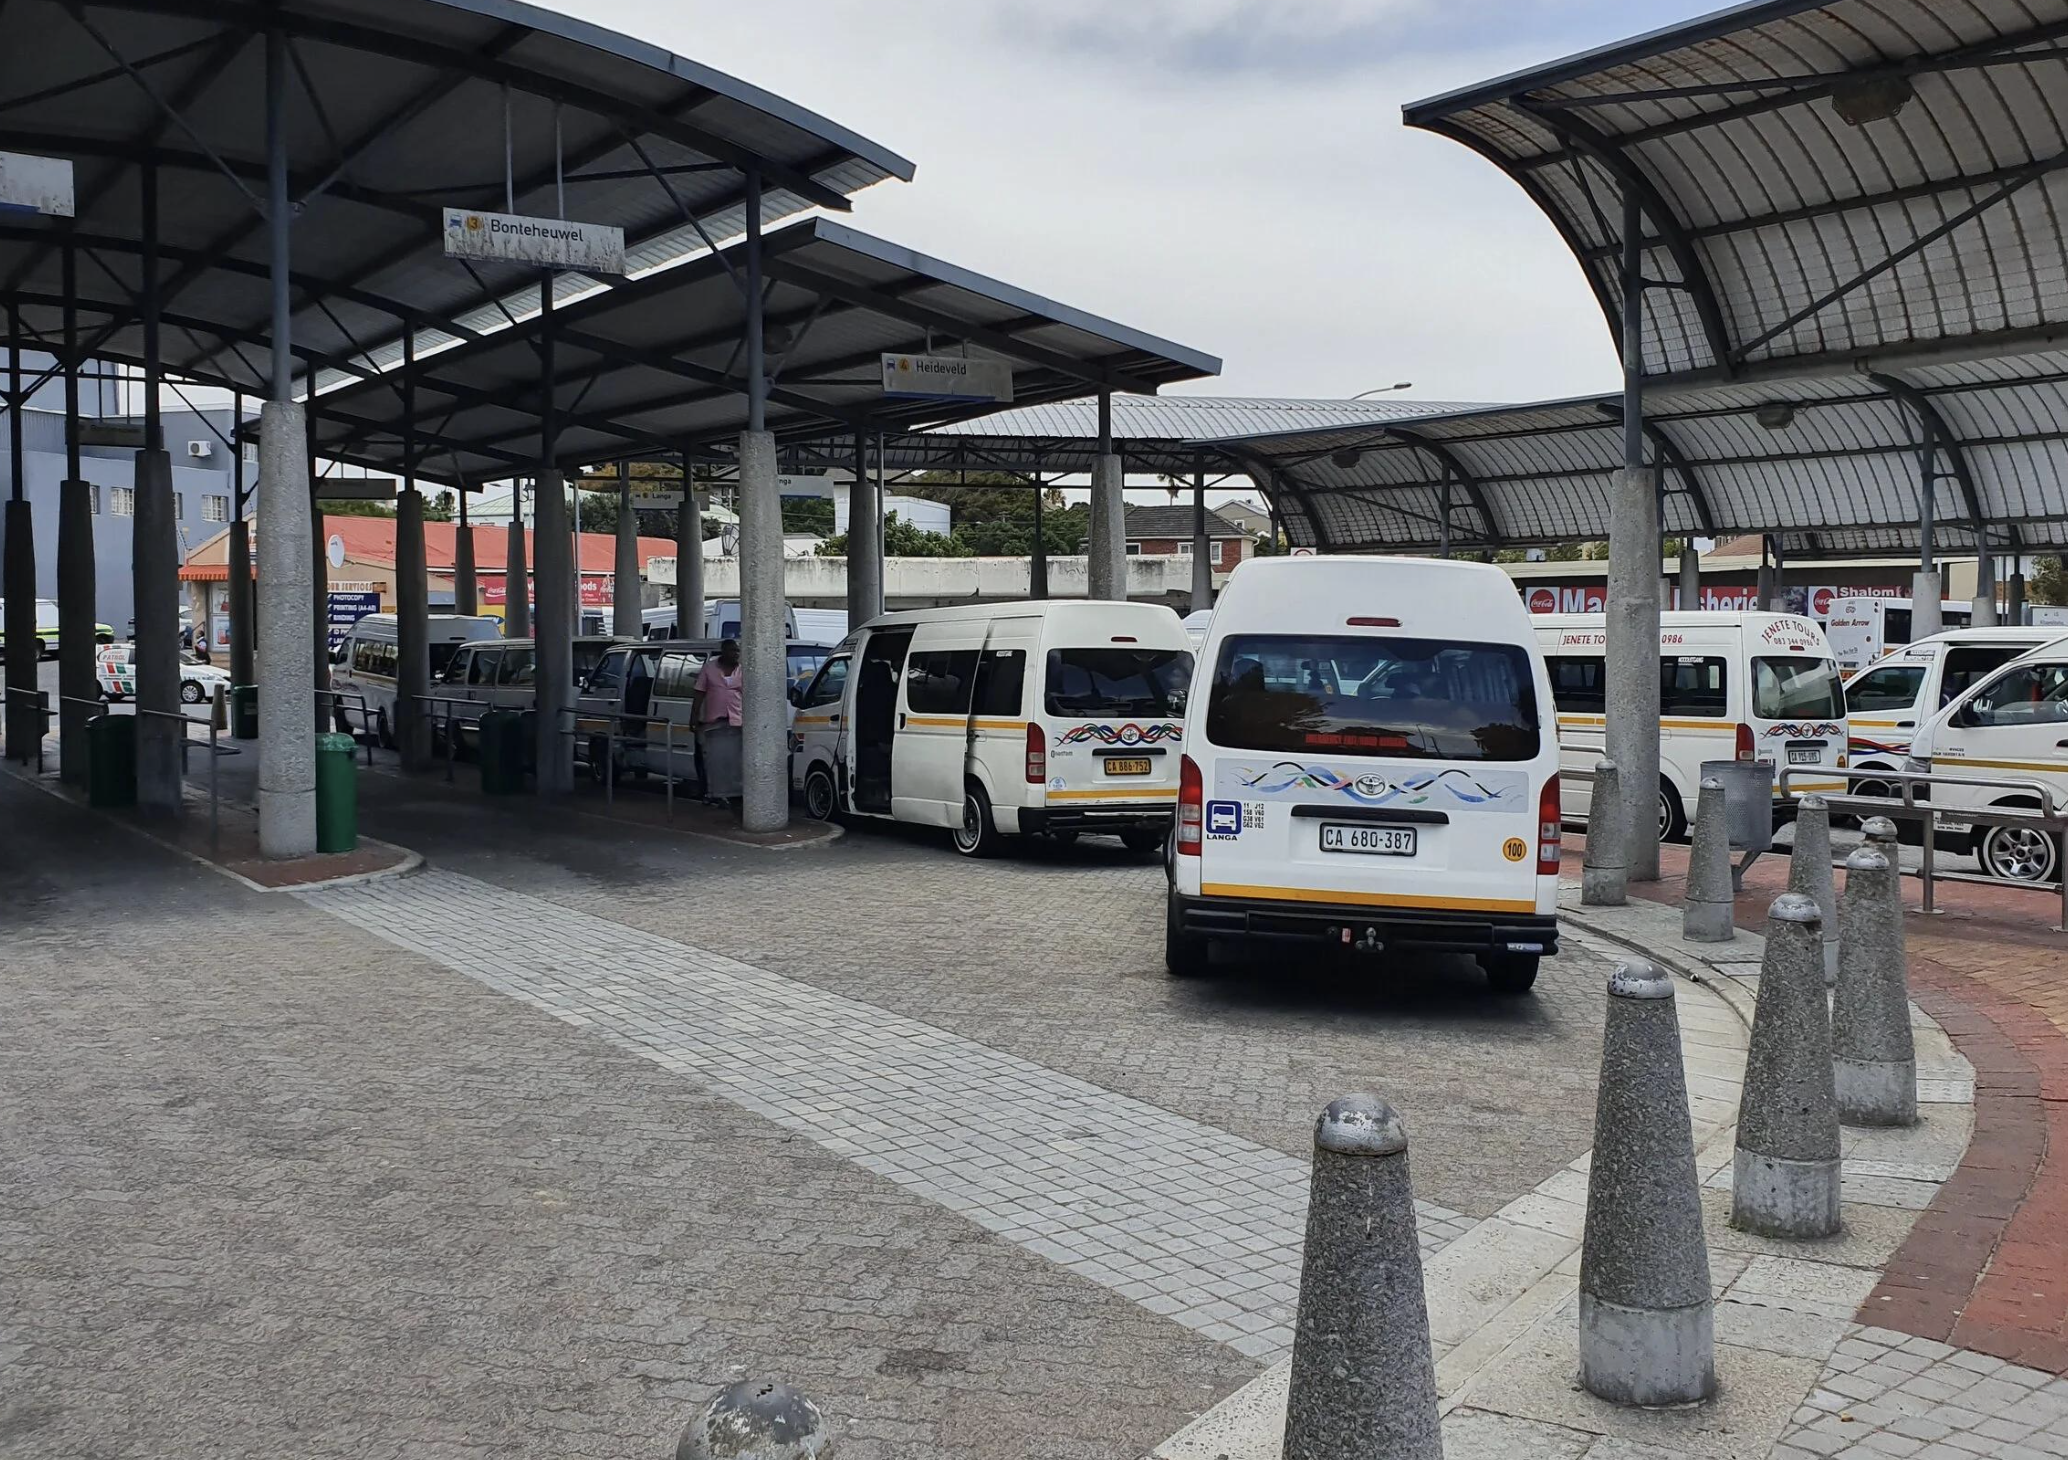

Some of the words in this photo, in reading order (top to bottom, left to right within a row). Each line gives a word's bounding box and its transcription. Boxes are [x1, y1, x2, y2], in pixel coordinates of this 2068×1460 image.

[490, 219, 584, 242] Bonteheuwel
[916, 361, 967, 375] Heideveld
[652, 492, 672, 500] Langa
[1840, 586, 1895, 597] Shalom
[1530, 598, 1554, 608] Coca-Cola
[1563, 588, 1607, 613] Ma
[1831, 618, 1850, 627] Golden
[1851, 618, 1870, 627] Arrow
[1761, 619, 1791, 645] JENETE
[1791, 620, 1820, 646] TOURS
[1562, 635, 1592, 645] JENETE
[1661, 634, 1683, 643] 0986
[102, 653, 126, 661] PATROL
[1107, 761, 1117, 772] CA
[1325, 829, 1343, 846] CA
[1351, 830, 1412, 850] 680-387
[1507, 842, 1523, 858] 100
